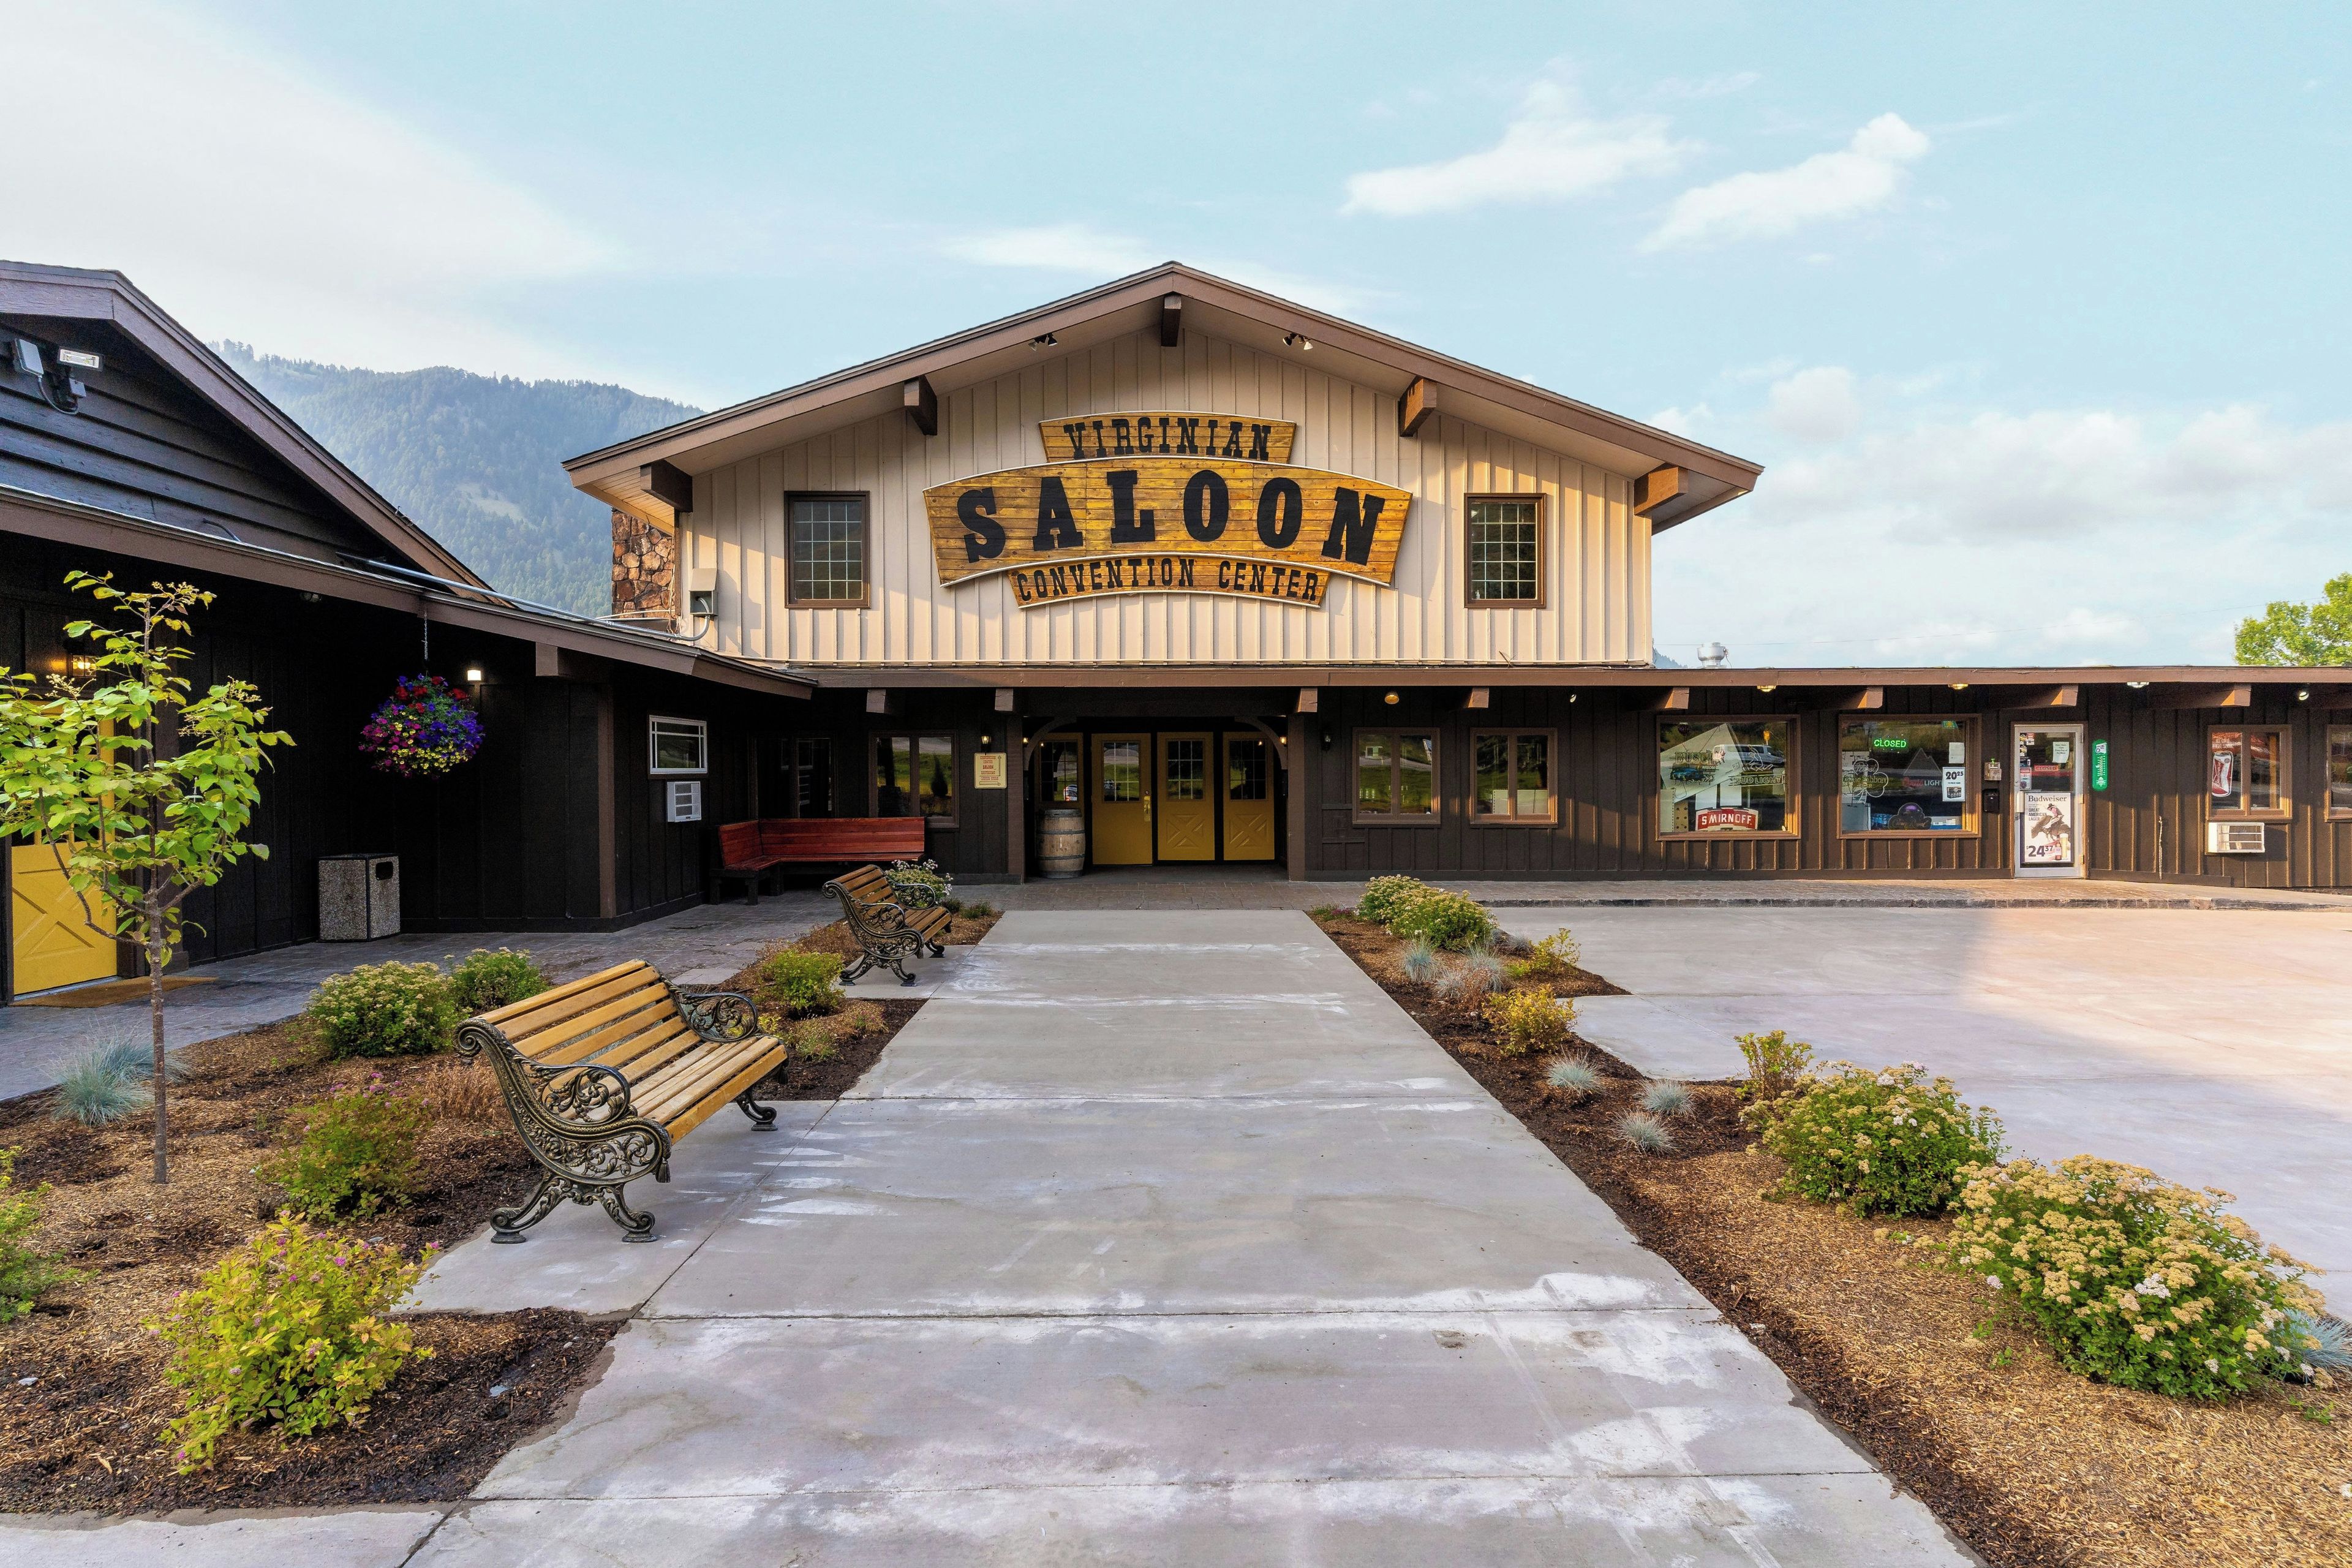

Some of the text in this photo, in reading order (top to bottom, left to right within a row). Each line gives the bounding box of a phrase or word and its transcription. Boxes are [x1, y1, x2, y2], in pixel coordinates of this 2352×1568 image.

[1063, 417, 1272, 461] VIRGINIAN
[957, 469, 1386, 567] SALOON
[1017, 557, 1319, 603] CONVENTION CENTER
[1874, 739, 1907, 748] CLOSED
